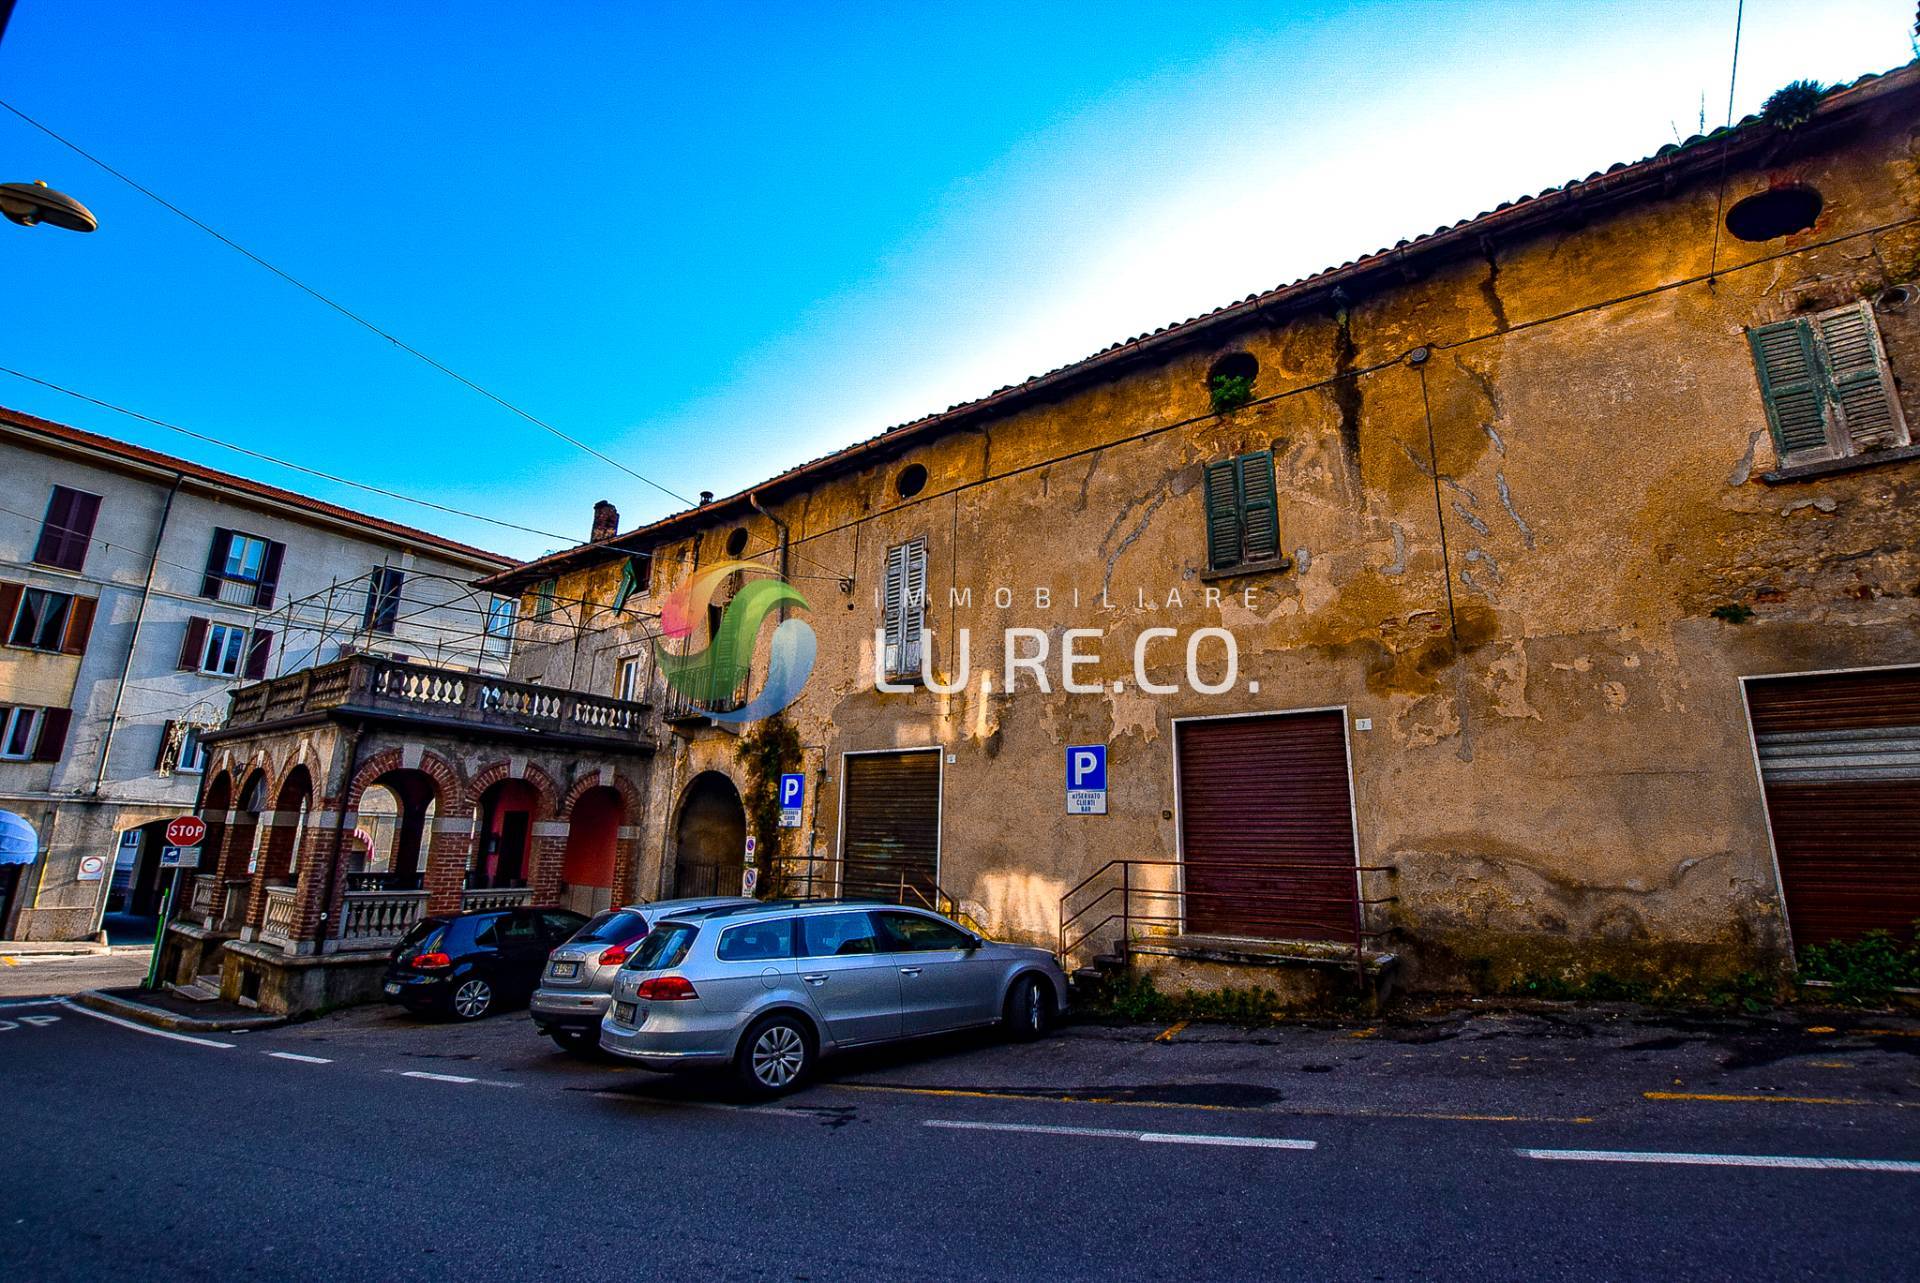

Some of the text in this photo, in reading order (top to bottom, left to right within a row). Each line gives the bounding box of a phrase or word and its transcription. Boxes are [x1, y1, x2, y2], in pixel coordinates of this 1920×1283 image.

[1075, 752, 1097, 785] P
[784, 778, 799, 805] P
[170, 825, 204, 837] STOP
